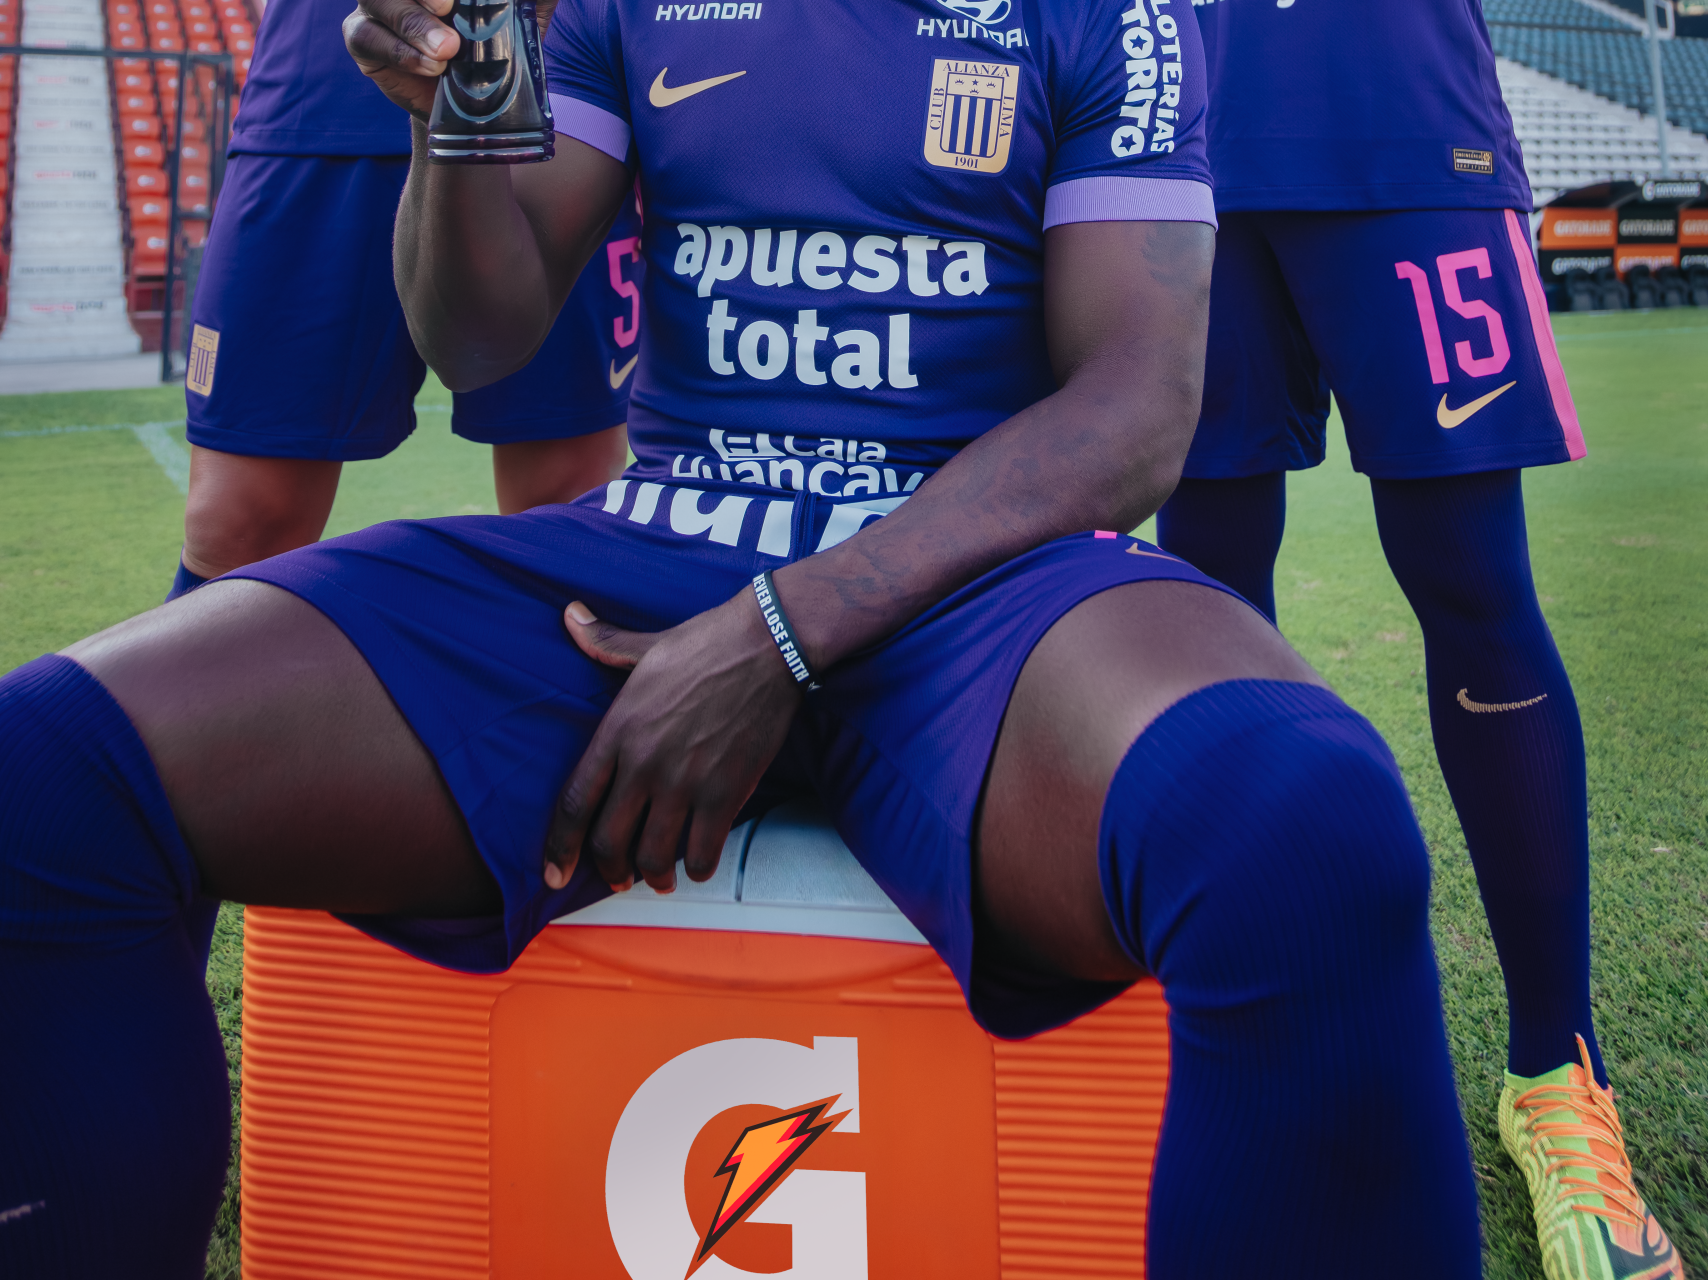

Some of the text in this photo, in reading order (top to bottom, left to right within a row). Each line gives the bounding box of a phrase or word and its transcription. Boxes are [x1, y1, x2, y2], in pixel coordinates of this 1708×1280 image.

[656, 2, 762, 21] HYUNDAI
[943, 62, 1010, 77] ALIANZA
[1111, 0, 1158, 158] TORITO
[930, 87, 945, 130] CLUB
[999, 95, 1015, 137] LIMA
[954, 156, 979, 169] 1901
[1553, 220, 1613, 237] GATORADE
[1619, 219, 1675, 236] GATORADE
[673, 223, 990, 297] apuesta
[1395, 247, 1511, 384] 15
[706, 299, 919, 390] total
[764, 605, 789, 644] LOSE
[780, 640, 810, 682] FAITH
[605, 1035, 869, 1280] G
